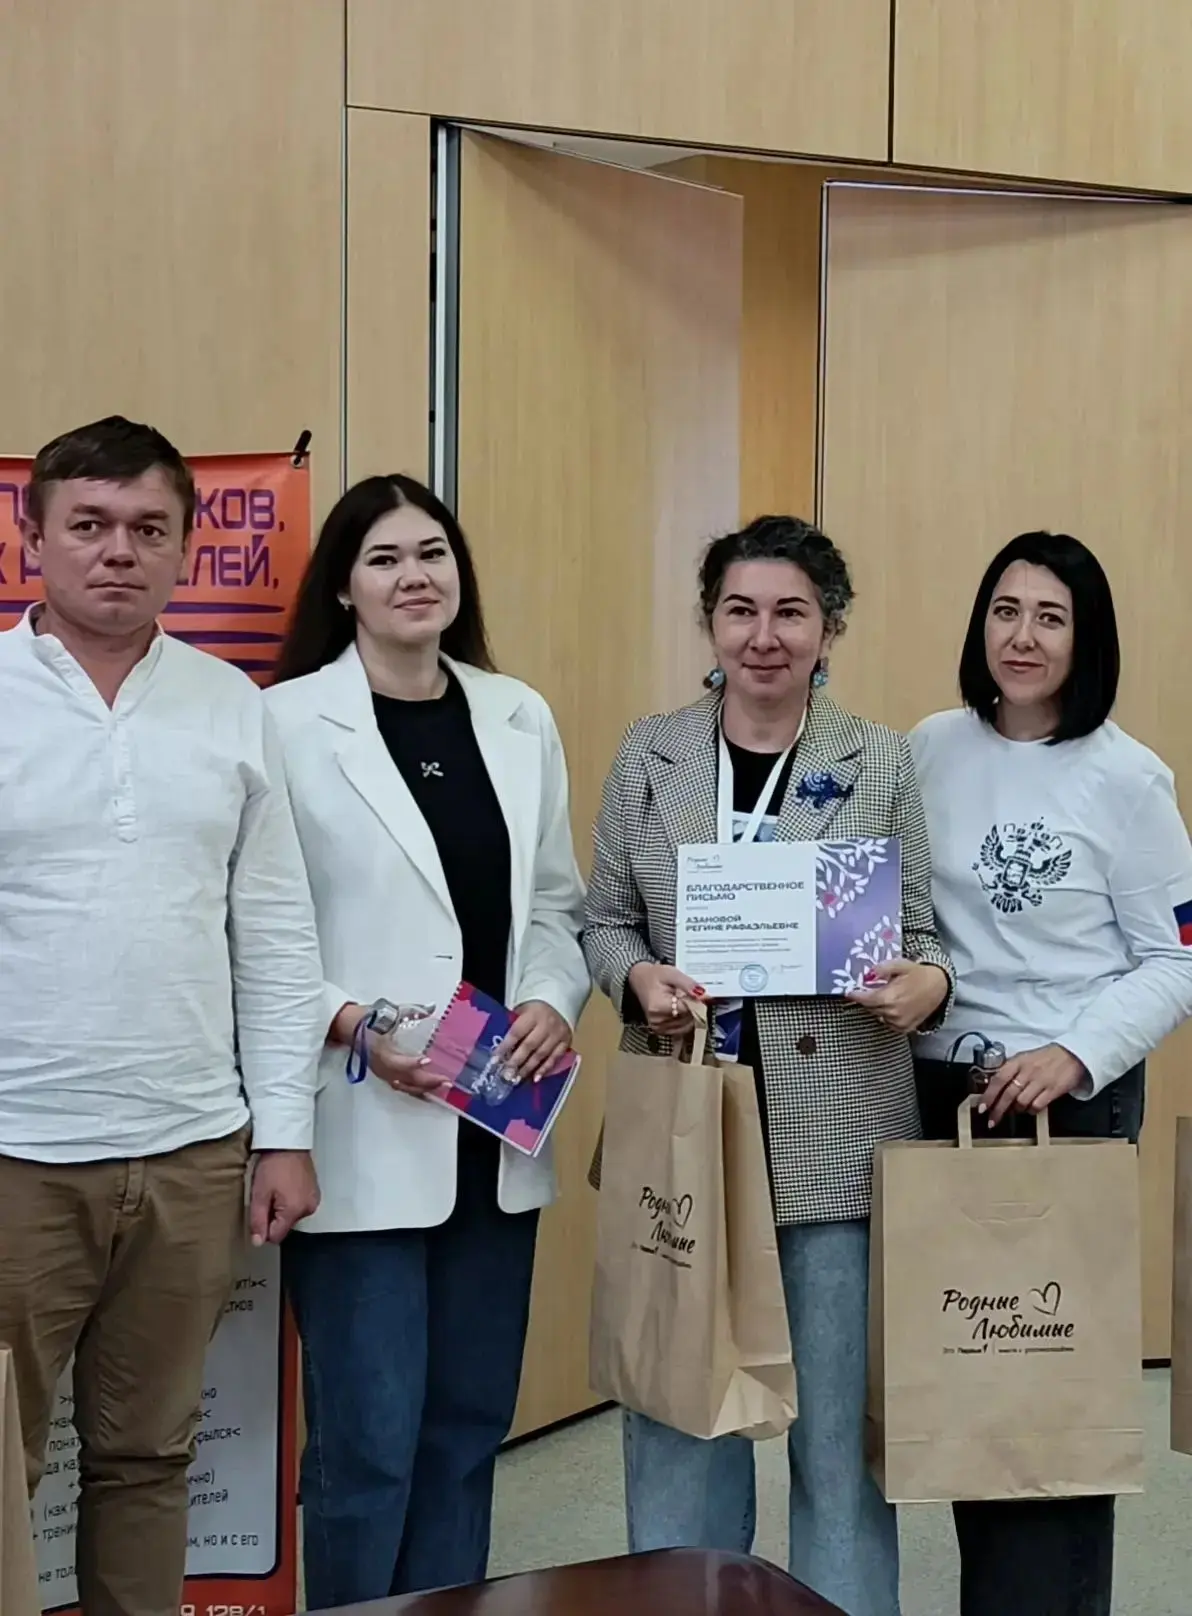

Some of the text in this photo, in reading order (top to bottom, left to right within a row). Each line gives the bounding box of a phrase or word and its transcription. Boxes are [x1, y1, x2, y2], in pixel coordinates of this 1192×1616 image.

[195, 487, 285, 533] КОВ,
[686, 881, 805, 893] БЛАГОДАРСТВЕННОЕ
[686, 893, 736, 902] ПИСЬМО
[685, 924, 723, 932] РЕГИНЕ
[686, 914, 741, 924] АЗАНОВОЙ
[942, 1289, 1020, 1320] Родные
[972, 1314, 1075, 1340] Любимые
[188, 1488, 228, 1508] ителей
[43, 1523, 77, 1542] трени
